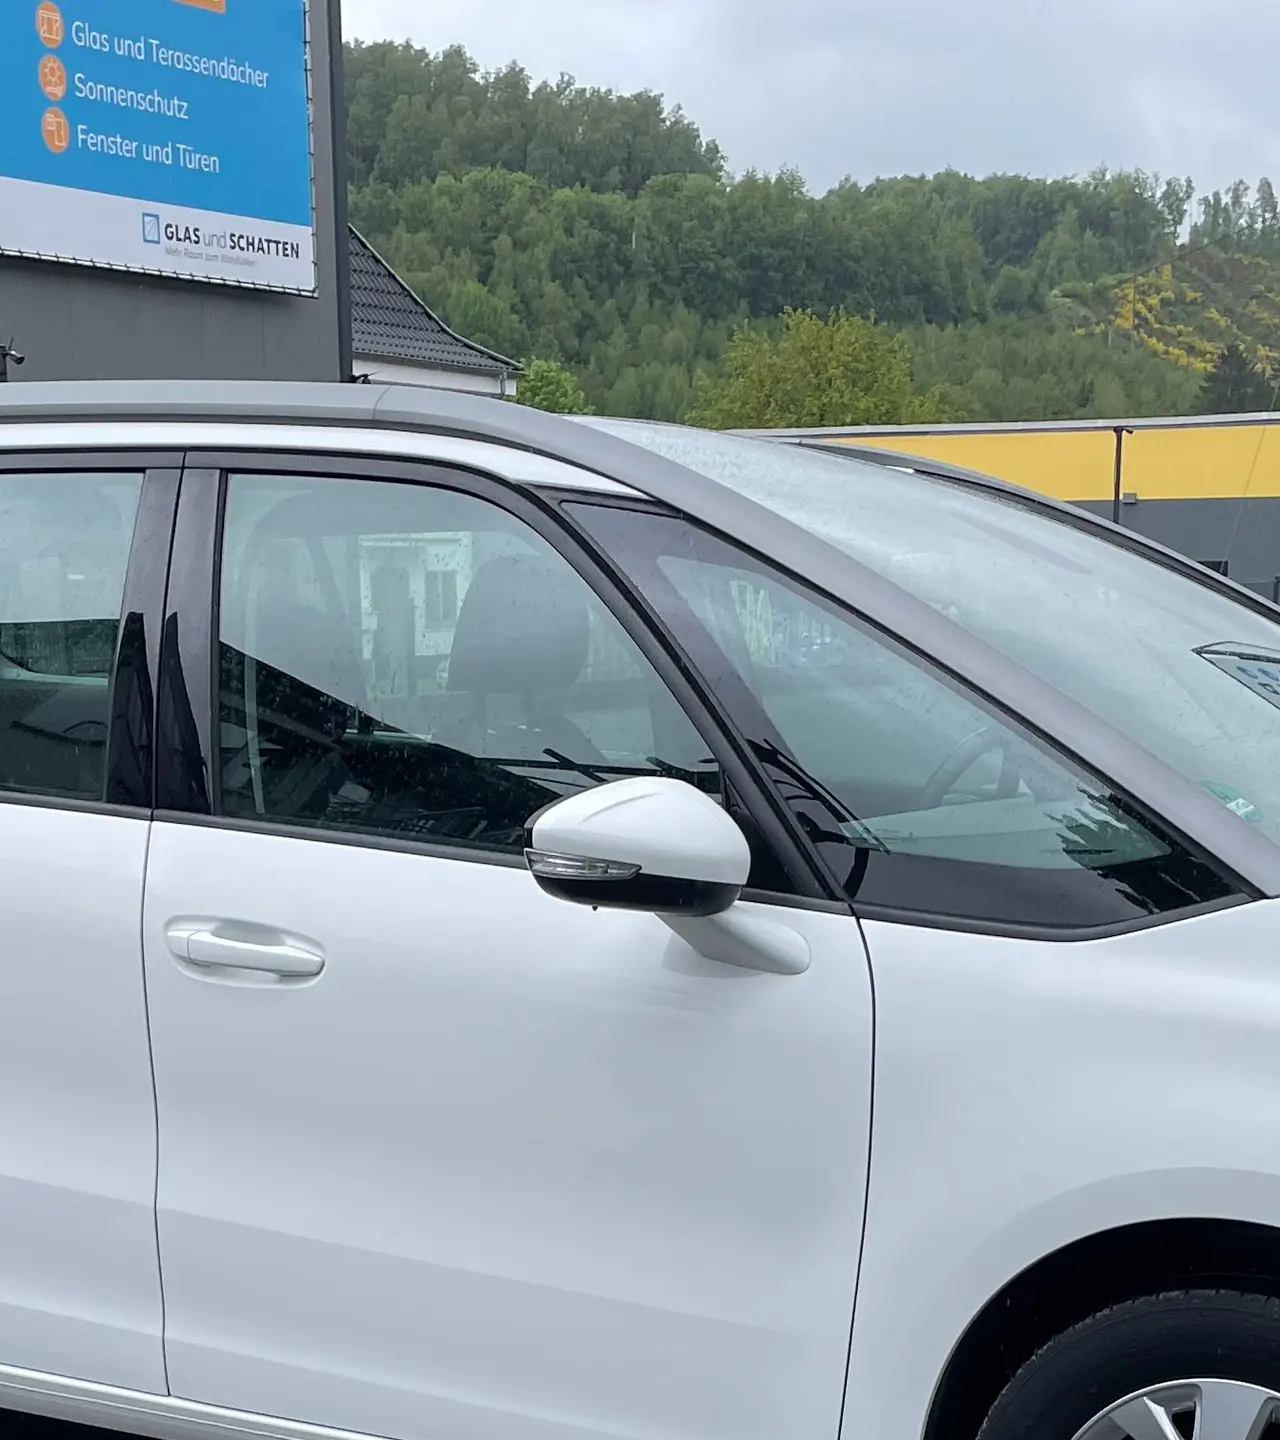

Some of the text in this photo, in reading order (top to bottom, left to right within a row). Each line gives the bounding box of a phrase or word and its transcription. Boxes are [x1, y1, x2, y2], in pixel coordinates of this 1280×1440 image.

[71, 20, 269, 88] Glas und Terassendächer
[74, 73, 189, 120] Sonnenschutz
[77, 124, 220, 173] Fenster und Türen
[164, 222, 300, 259] GLAS und SCHATTEN
